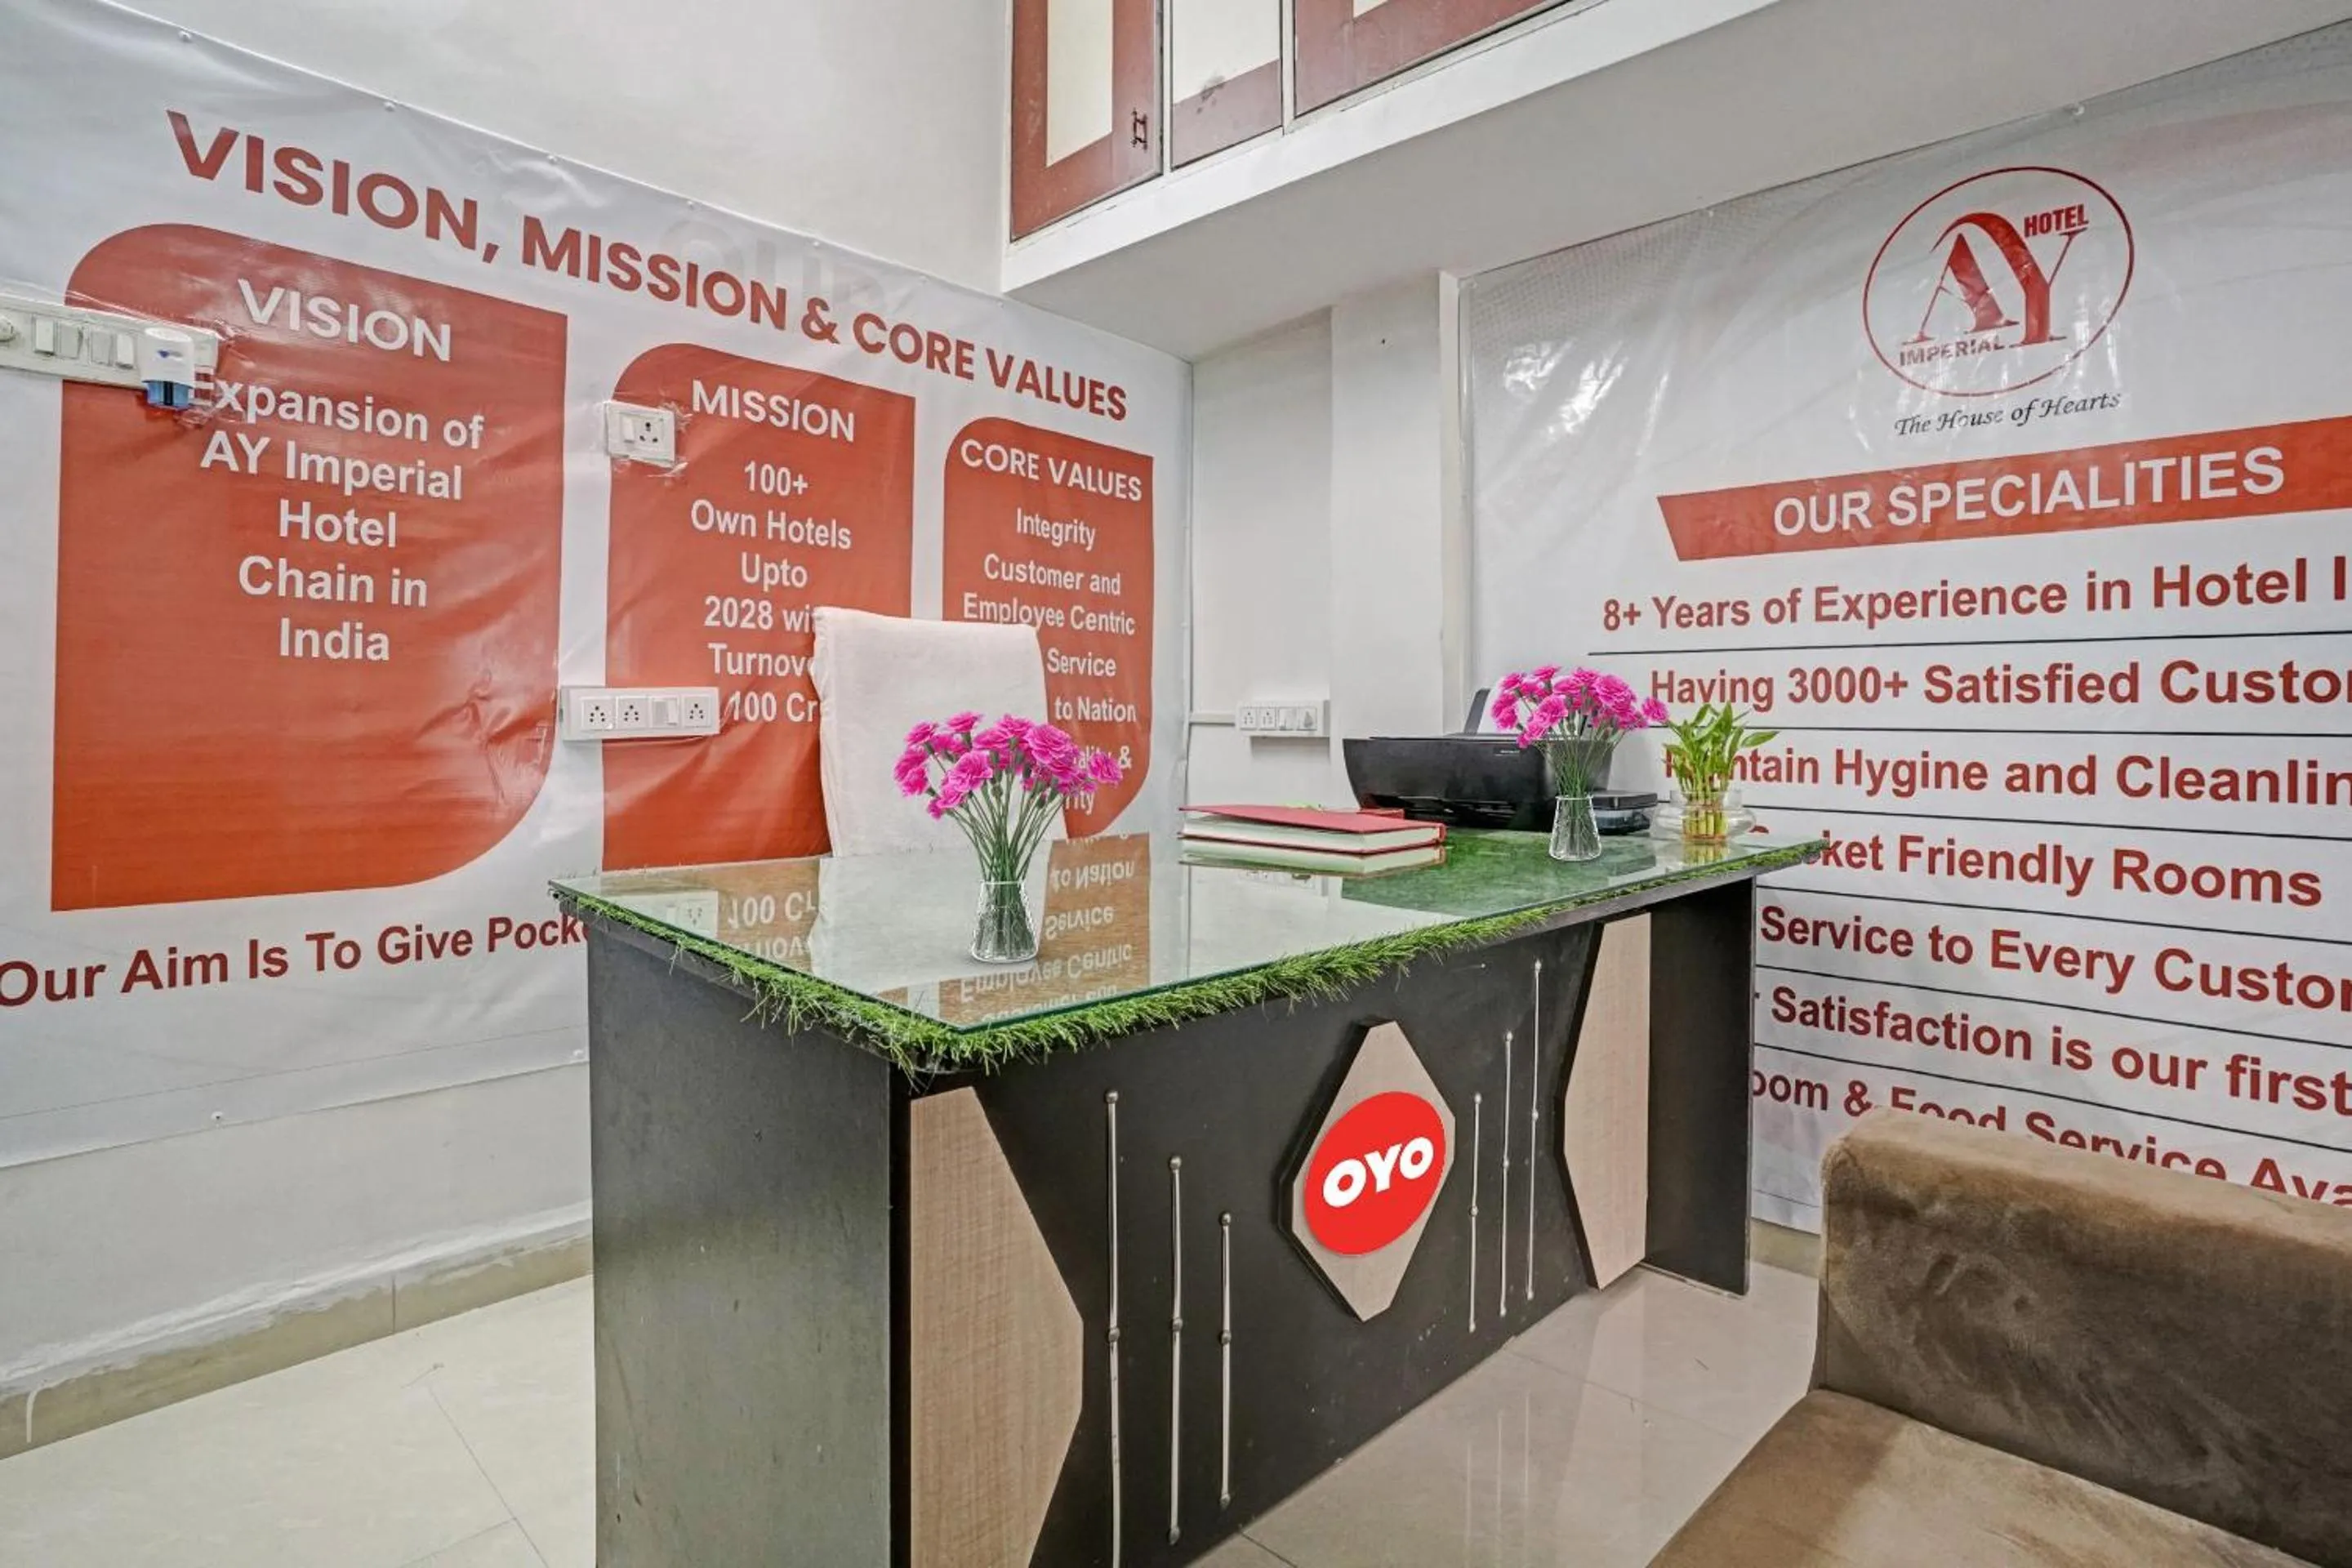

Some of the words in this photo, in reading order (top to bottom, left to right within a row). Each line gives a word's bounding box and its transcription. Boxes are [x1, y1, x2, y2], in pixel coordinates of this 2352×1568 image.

[2024, 204, 2089, 238] HOTEL
[167, 110, 500, 263] VISION,
[523, 215, 786, 331] MISSION
[800, 297, 840, 344] &
[853, 312, 974, 381] CORE
[986, 348, 1128, 421] VALUES
[238, 279, 452, 362] VISION
[1899, 336, 2006, 367] IMPERIAL
[189, 368, 428, 442] Expansion
[443, 414, 483, 449] of
[693, 380, 855, 443] MISSION
[1895, 414, 1931, 436] The
[1936, 410, 2003, 432] House
[2011, 399, 2042, 427] of
[2038, 392, 2122, 418] Hearts
[200, 431, 270, 474] AY
[287, 439, 462, 501] Imperial
[744, 461, 808, 497] 100+
[960, 439, 1040, 480] CORE
[1047, 457, 1143, 501] VALUES
[1774, 490, 1872, 537] OUR
[1888, 446, 2285, 526] SPECIALITIES
[279, 499, 397, 548] Hotel
[691, 499, 757, 537] Own
[767, 510, 851, 550] Hotels
[1016, 508, 1096, 551] Integrity
[238, 556, 374, 604] Chain
[392, 569, 427, 608] in
[742, 551, 808, 592] Upto
[984, 553, 1084, 590] Customer
[1089, 572, 1121, 596] and
[1603, 599, 1642, 632] 8+
[1651, 595, 1750, 629] Years
[1763, 588, 1802, 624] of
[1814, 577, 2067, 628] Experience
[2087, 570, 2129, 611] in
[2153, 557, 2307, 608] Hotel
[704, 595, 773, 630] 2028
[782, 604, 815, 634] wi
[964, 592, 1065, 630] Employee
[1071, 605, 1136, 636] Centric
[279, 617, 390, 662] India
[707, 643, 813, 677] Turnov
[1047, 648, 1117, 677] Service
[732, 691, 777, 722] 100
[786, 693, 818, 722] Cr
[1054, 697, 1073, 720] to
[1078, 696, 1137, 723] Nation
[1651, 670, 1775, 713] Having
[1788, 667, 1909, 705] 3000+
[1924, 661, 2140, 704] Satisfied
[2160, 660, 2352, 704] Custo
[1835, 749, 1988, 799] Hygine
[2006, 755, 2097, 796] and
[1899, 833, 2093, 897] Friendly
[2114, 849, 2322, 906] Rooms
[0, 960, 105, 1007] Our
[121, 947, 228, 993] Aim
[249, 939, 289, 978] Is
[305, 932, 362, 973] To
[377, 924, 473, 965] Give
[488, 914, 590, 952] Pock
[1761, 906, 1913, 957] Service
[1929, 924, 1973, 964] to
[1991, 929, 2135, 994] Every
[2154, 947, 2352, 1012] Custo
[1771, 986, 2032, 1061] Satisfaction
[2051, 1026, 2093, 1071] is
[2112, 1047, 2208, 1090] our
[2225, 1054, 2352, 1116] first
[1753, 1070, 1829, 1111] oom
[1843, 1080, 1873, 1117] &
[1322, 1136, 1434, 1208] OYO
